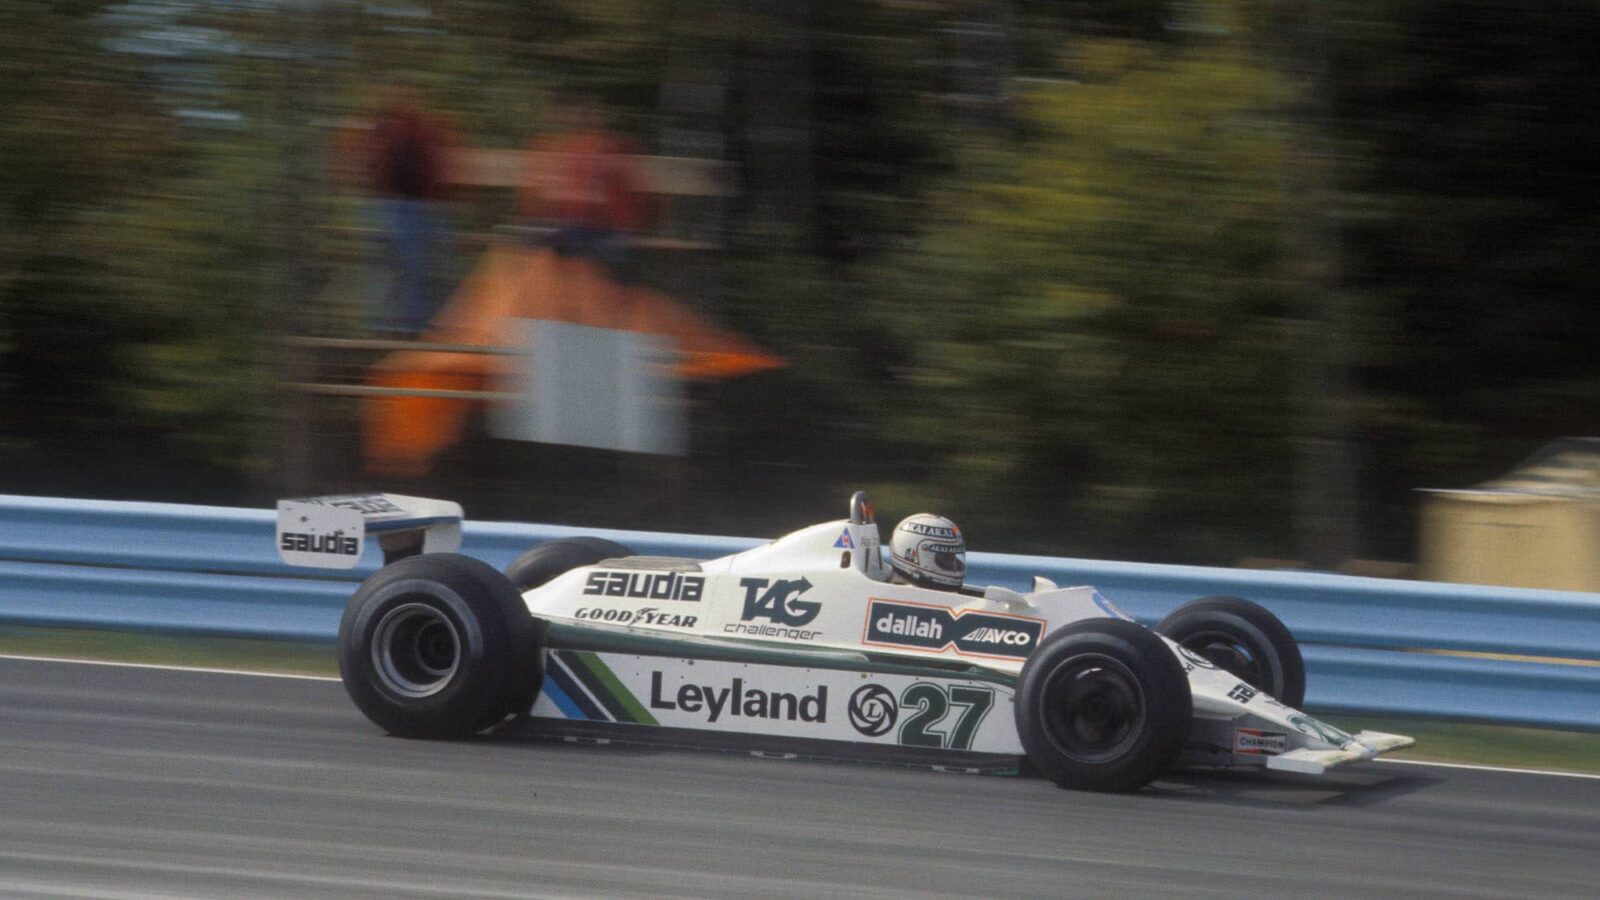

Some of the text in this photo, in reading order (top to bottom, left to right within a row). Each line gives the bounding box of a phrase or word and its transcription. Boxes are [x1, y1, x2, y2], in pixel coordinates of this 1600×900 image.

[281, 530, 358, 556] saudia
[583, 571, 705, 602] saudia
[739, 576, 822, 627] TAG
[724, 623, 822, 641] challenger
[876, 613, 943, 640] dallah
[980, 628, 1031, 646] AVCO
[651, 670, 828, 723] Leyland
[867, 703, 881, 718] L
[898, 682, 995, 750] 27
